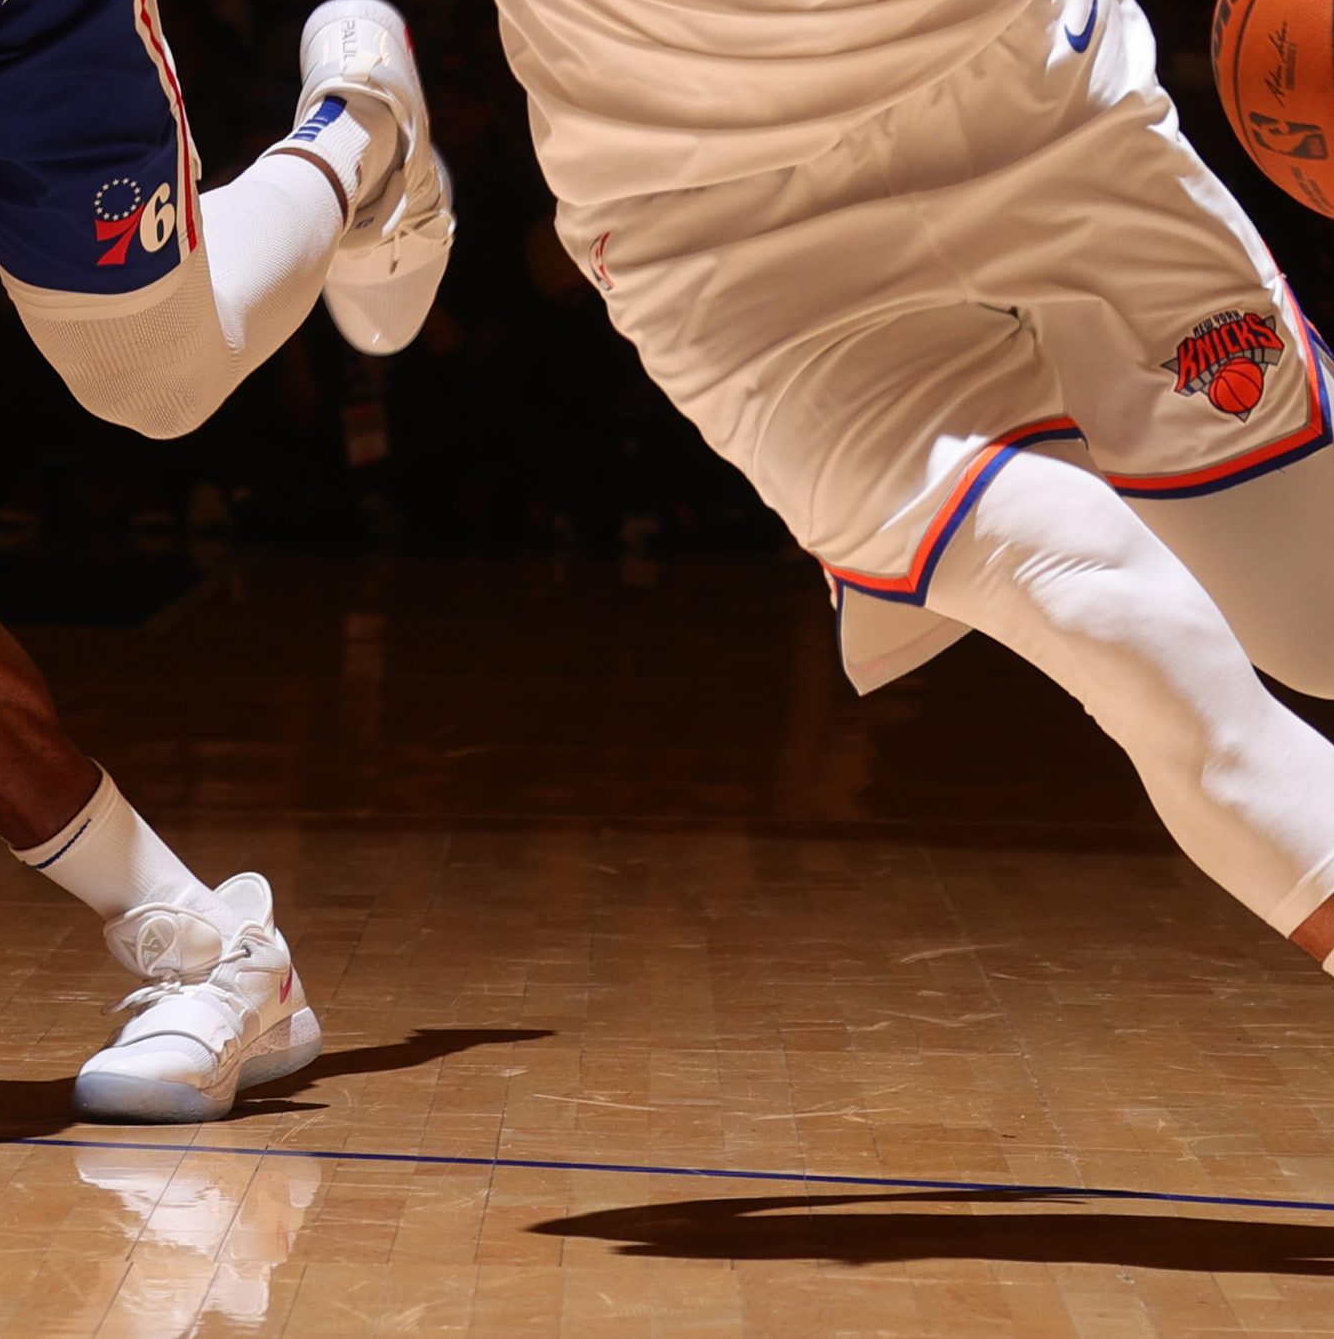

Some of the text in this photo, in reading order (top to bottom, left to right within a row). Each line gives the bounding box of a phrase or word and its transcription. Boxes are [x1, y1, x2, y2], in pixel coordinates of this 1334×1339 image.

[94, 182, 176, 267] 76
[1175, 312, 1285, 393] KNICKS
[1192, 309, 1243, 338] NEW YORK
